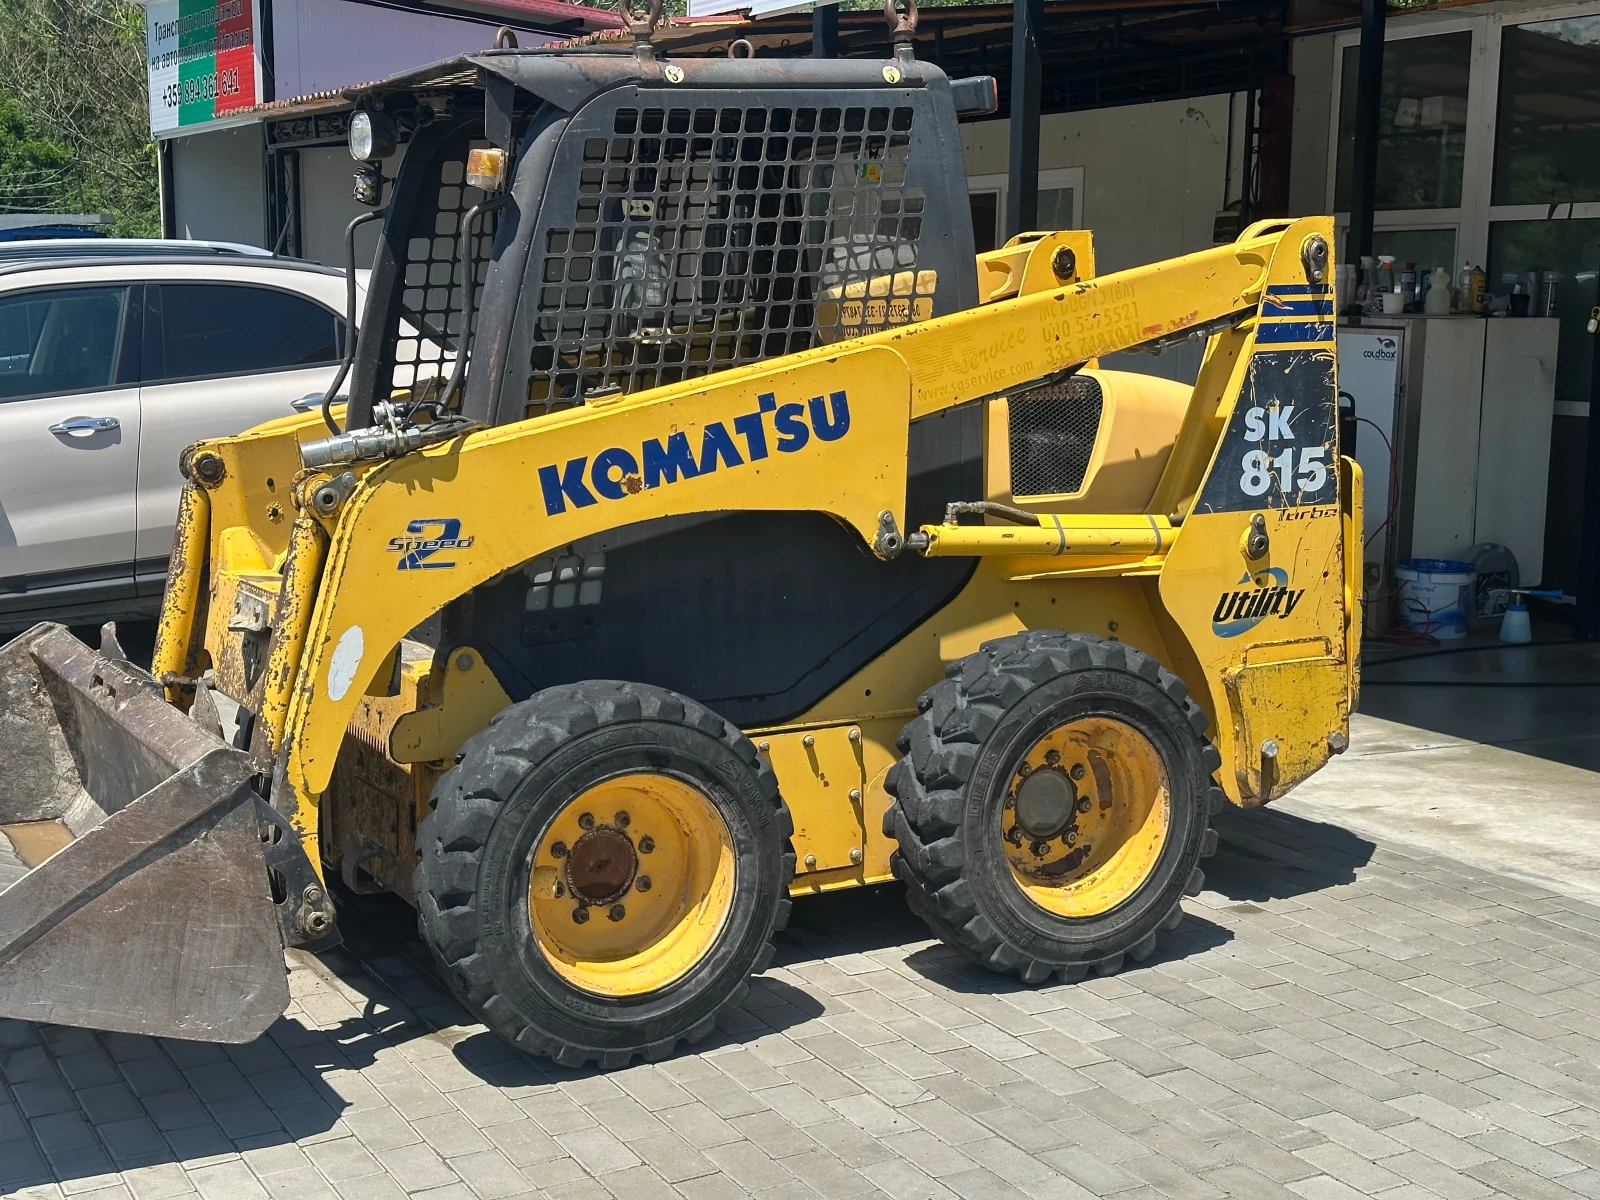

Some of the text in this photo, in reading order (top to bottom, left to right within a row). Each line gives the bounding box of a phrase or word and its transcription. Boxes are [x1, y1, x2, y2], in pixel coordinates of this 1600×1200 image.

[154, 14, 192, 45] Транспорт
[152, 55, 160, 72] на
[163, 67, 240, 108] +359 894 361 641
[1103, 301, 1139, 327] 5521
[1045, 341, 1075, 365] 335
[917, 360, 1034, 402] www.sgservice.com
[1243, 405, 1295, 442] SK
[537, 390, 851, 516] KOMATSU
[1240, 446, 1327, 497] 815
[386, 535, 475, 555] Speed
[1212, 586, 1306, 622] Utility
